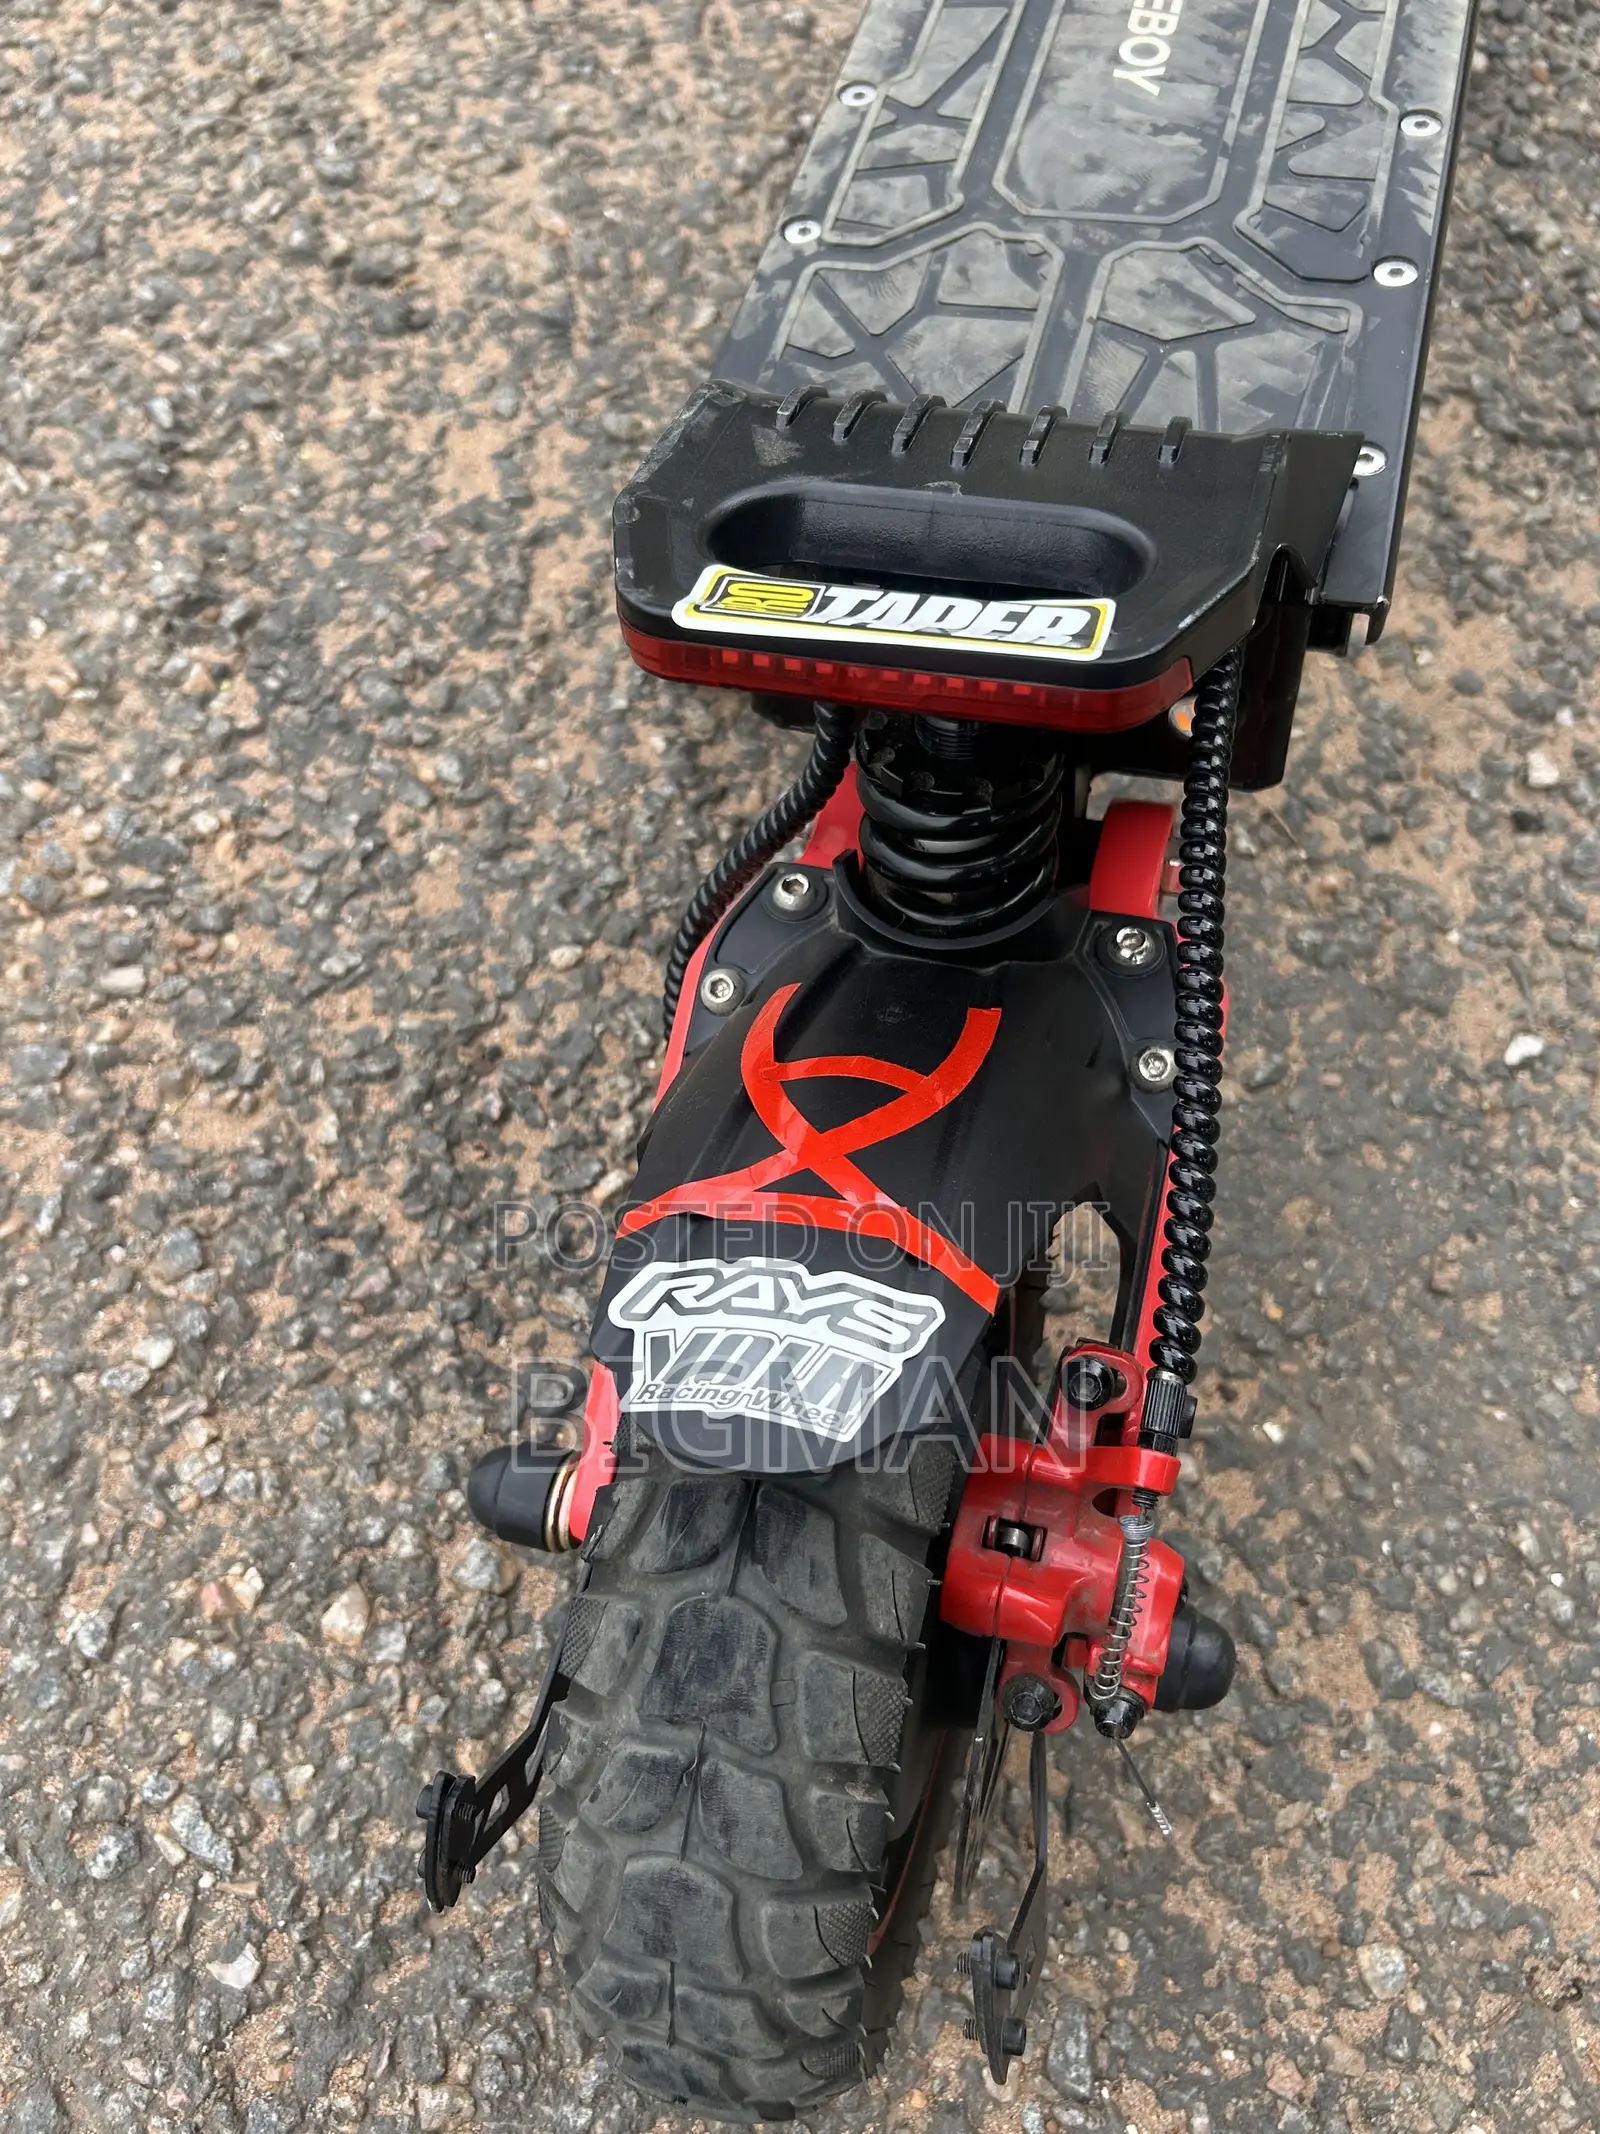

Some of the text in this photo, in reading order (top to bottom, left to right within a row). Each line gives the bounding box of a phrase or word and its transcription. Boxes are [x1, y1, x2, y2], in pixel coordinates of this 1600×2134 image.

[807, 587, 1091, 646] TAPER
[631, 1272, 928, 1344] RAYS
[639, 1378, 856, 1434] Racing Wheel
